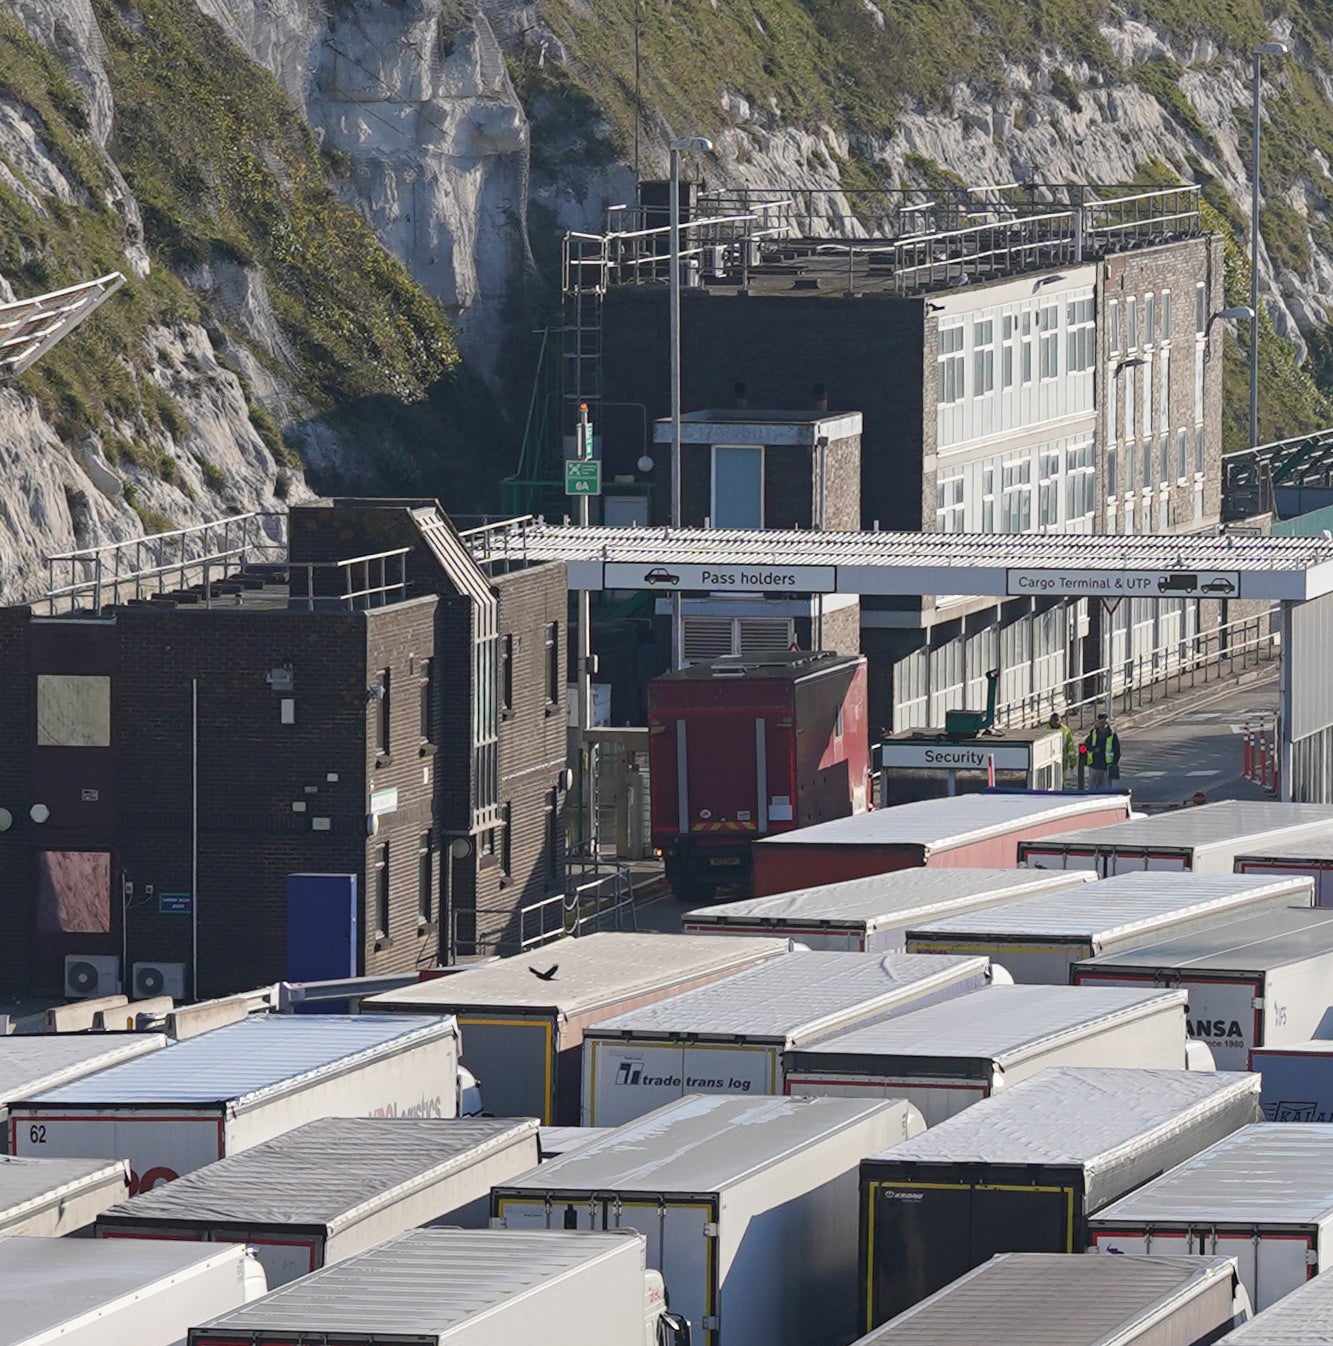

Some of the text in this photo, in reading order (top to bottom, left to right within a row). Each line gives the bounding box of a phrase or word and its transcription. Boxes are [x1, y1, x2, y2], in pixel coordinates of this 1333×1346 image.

[701, 571, 796, 585] Pass holders
[1018, 577, 1151, 590] Cargo Terminal & UTP
[925, 750, 984, 766] Security
[642, 1076, 752, 1091] trade trans log
[30, 1124, 47, 1144] 62
